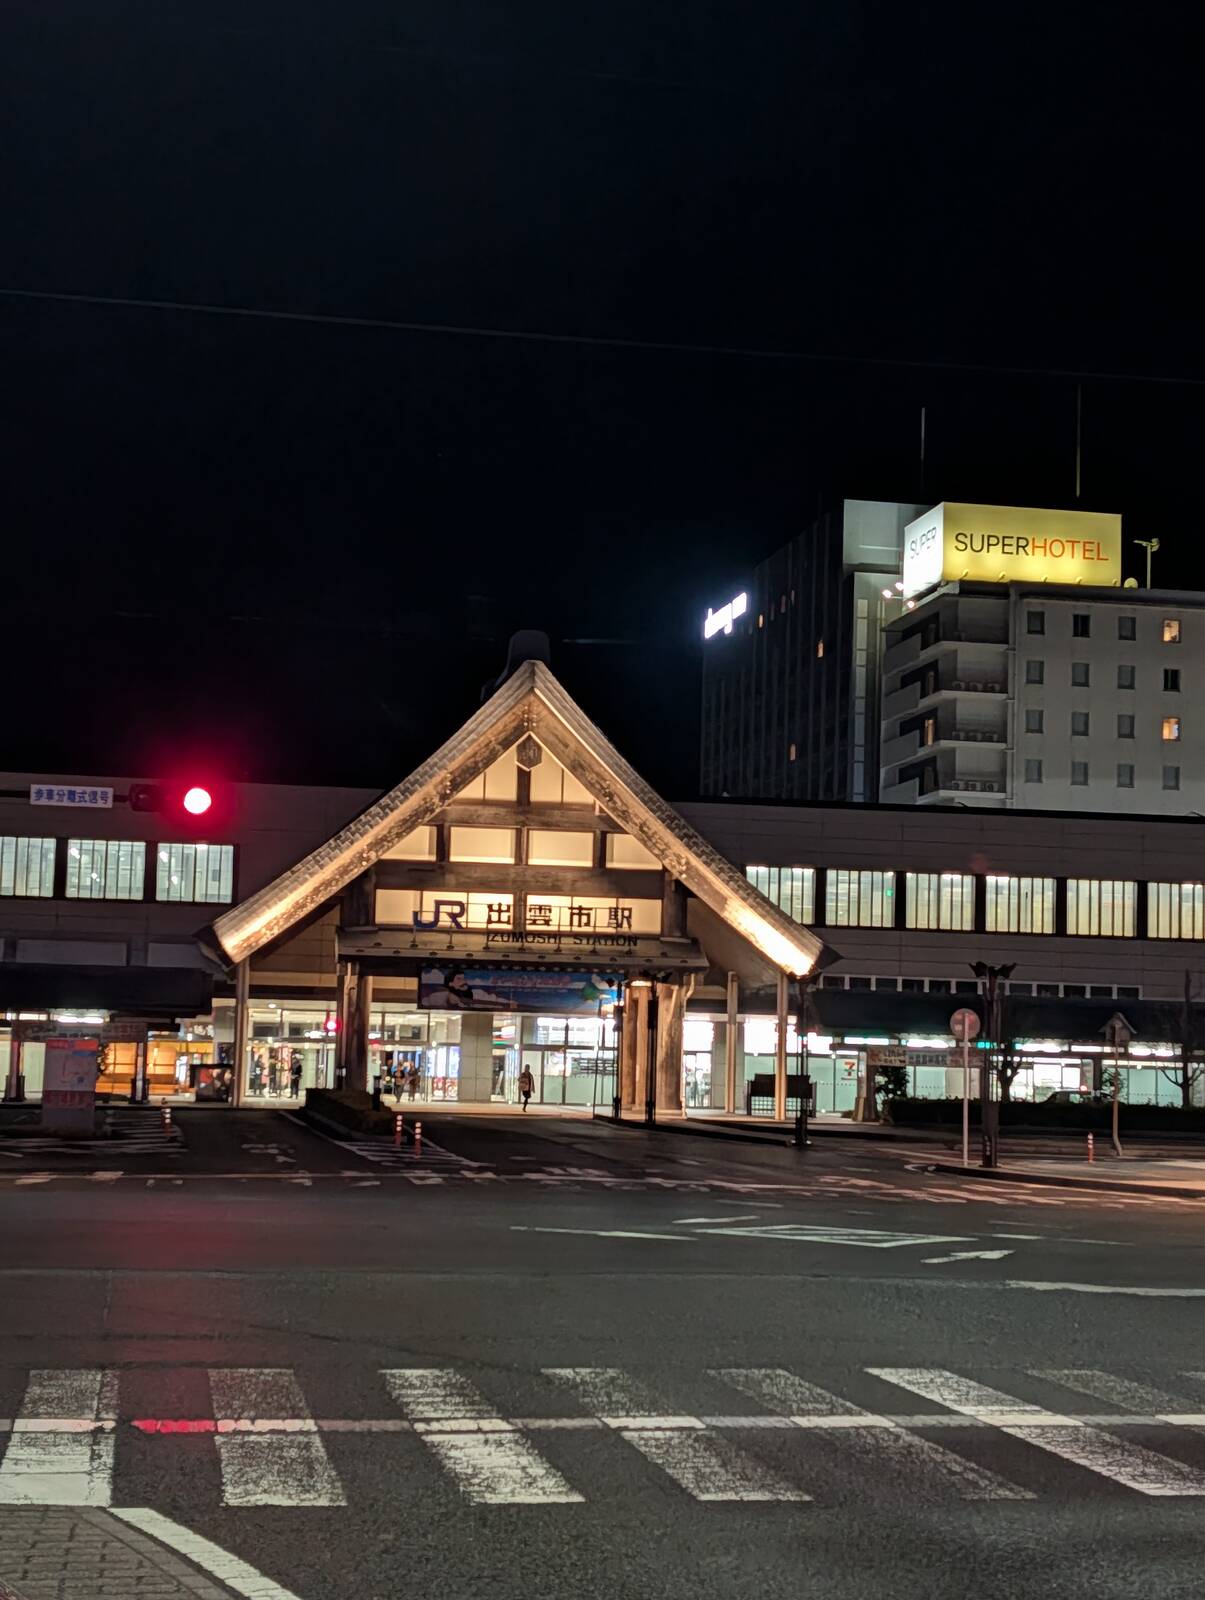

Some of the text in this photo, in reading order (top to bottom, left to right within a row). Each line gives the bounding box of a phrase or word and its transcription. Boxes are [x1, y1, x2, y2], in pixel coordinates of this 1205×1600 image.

[413, 899, 633, 929] JR 出雲市駅
[573, 935, 639, 947] STATION
